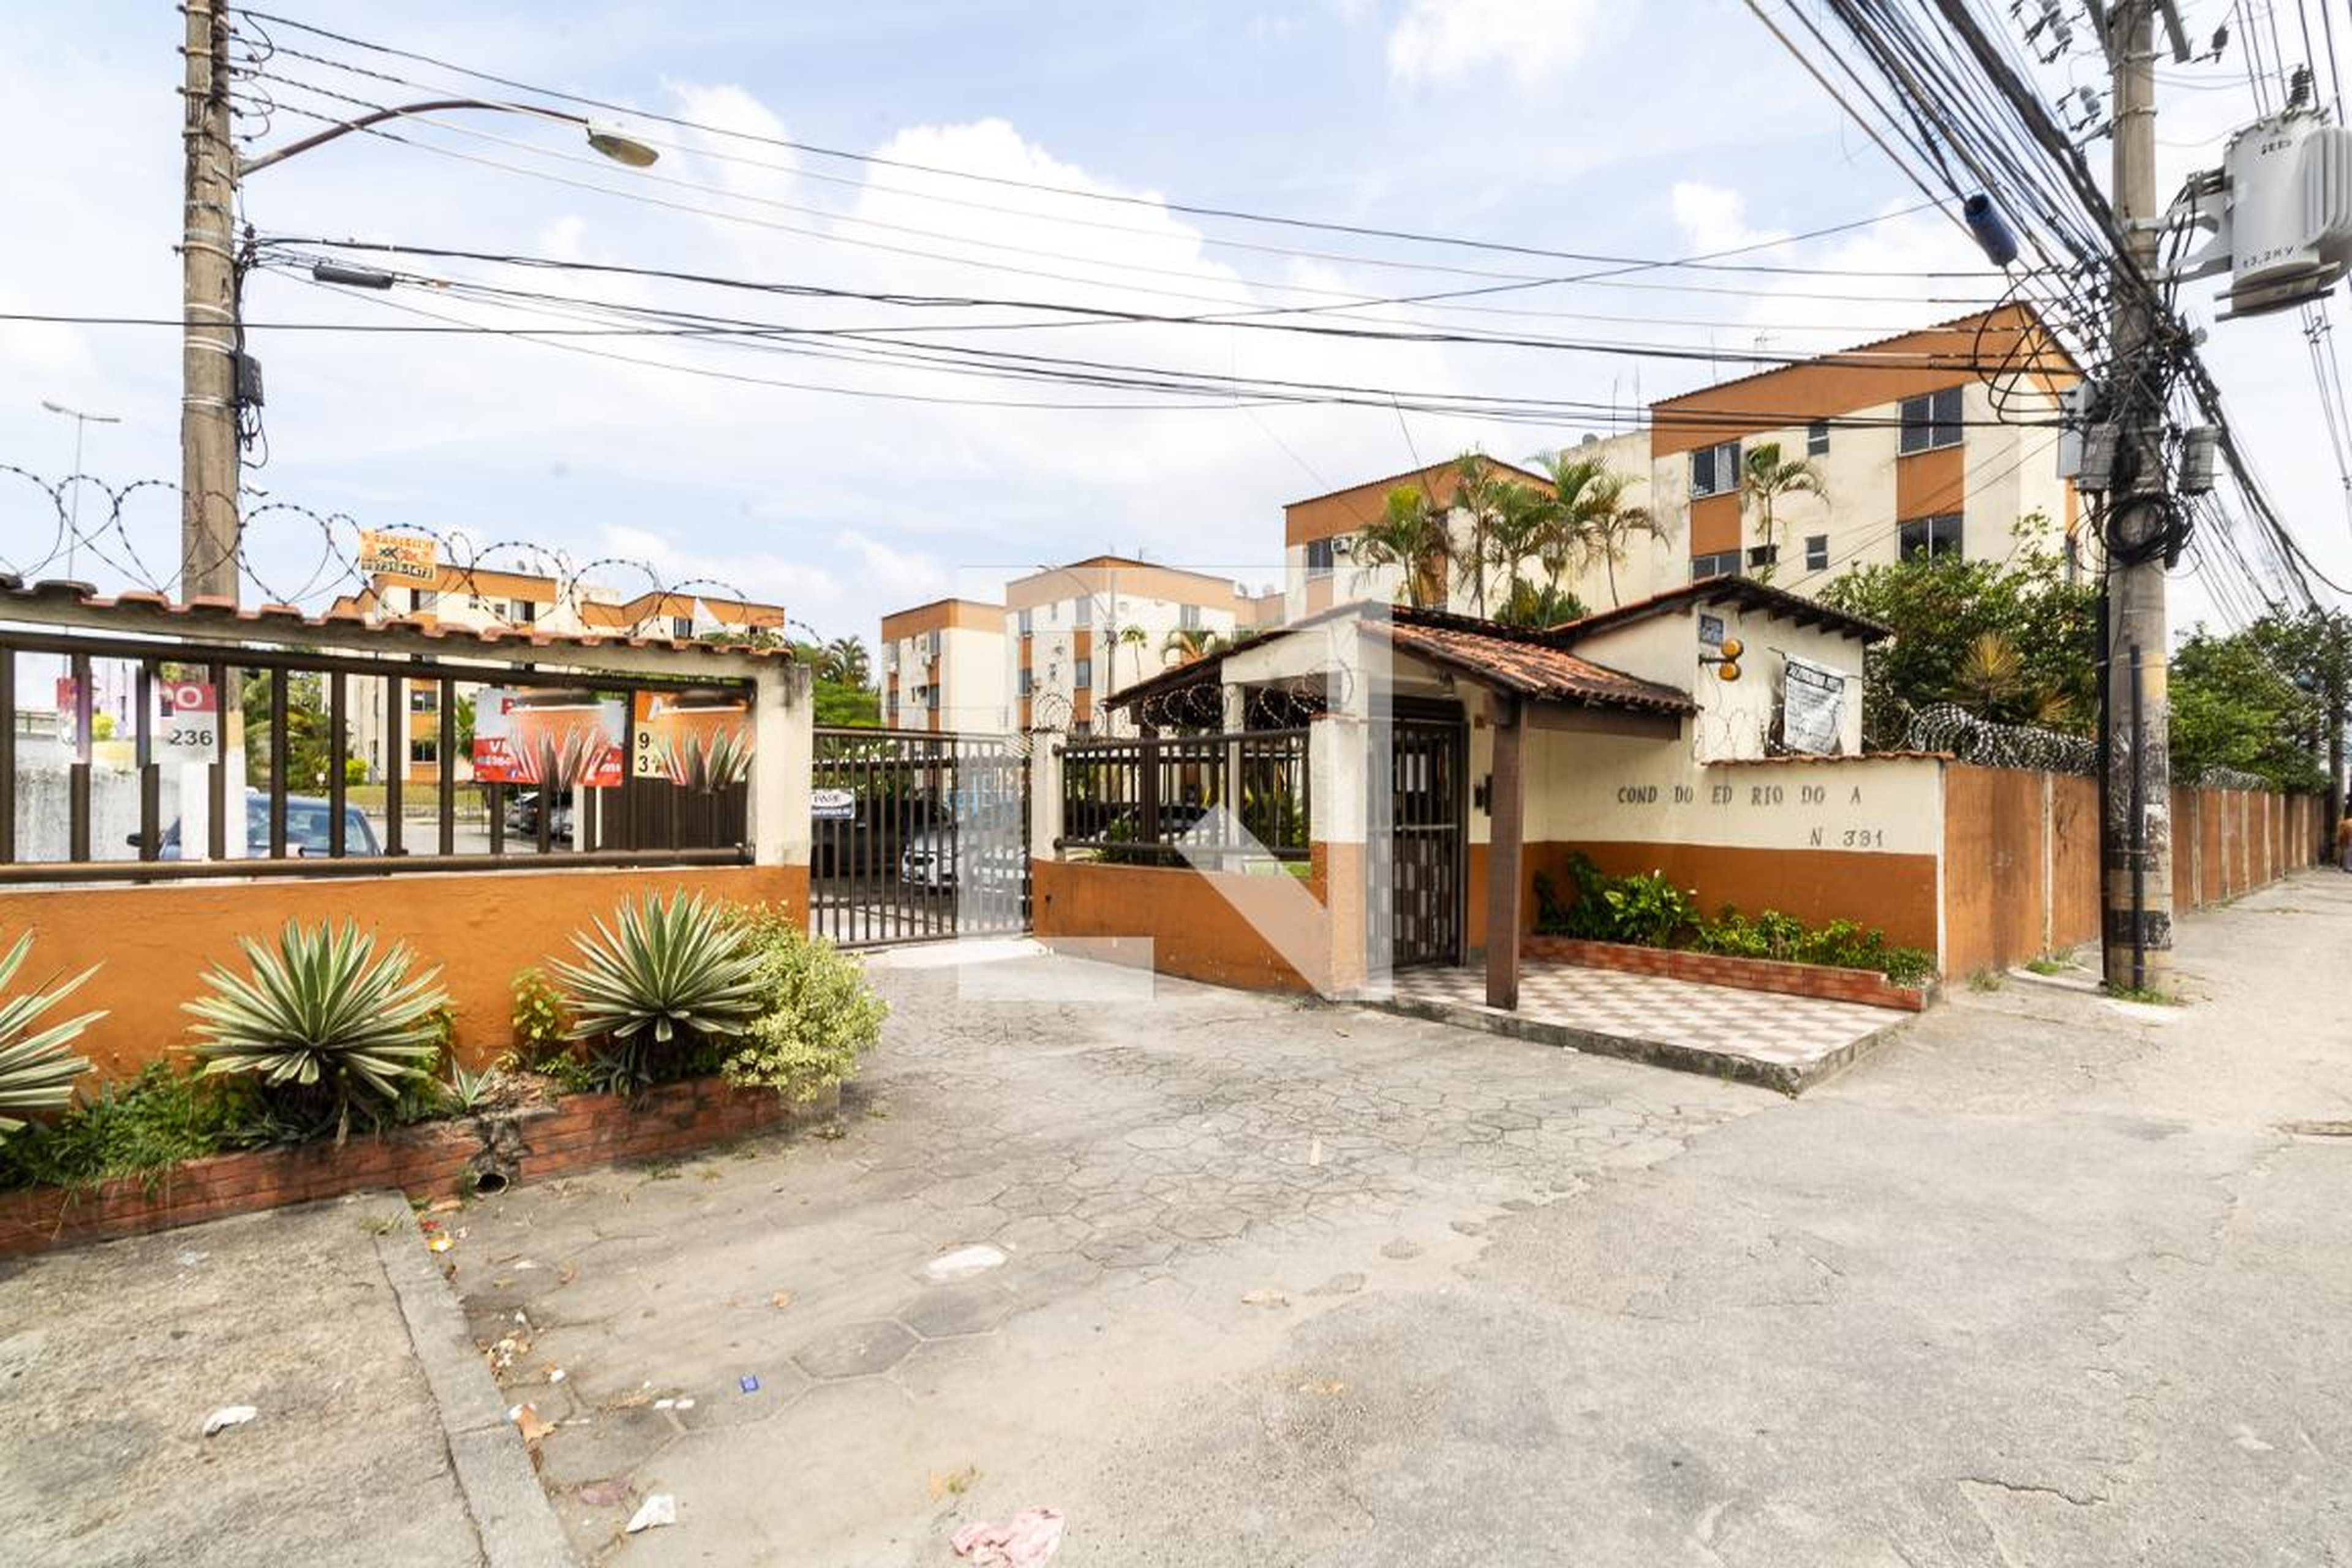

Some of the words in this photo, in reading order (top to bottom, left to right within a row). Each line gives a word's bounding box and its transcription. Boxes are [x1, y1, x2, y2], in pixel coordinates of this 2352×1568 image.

[1617, 785, 1657, 804] COND
[1712, 785, 1733, 804] ED
[1751, 786, 1783, 805] RIO
[1801, 786, 1826, 804] DO
[1850, 786, 1861, 804] A
